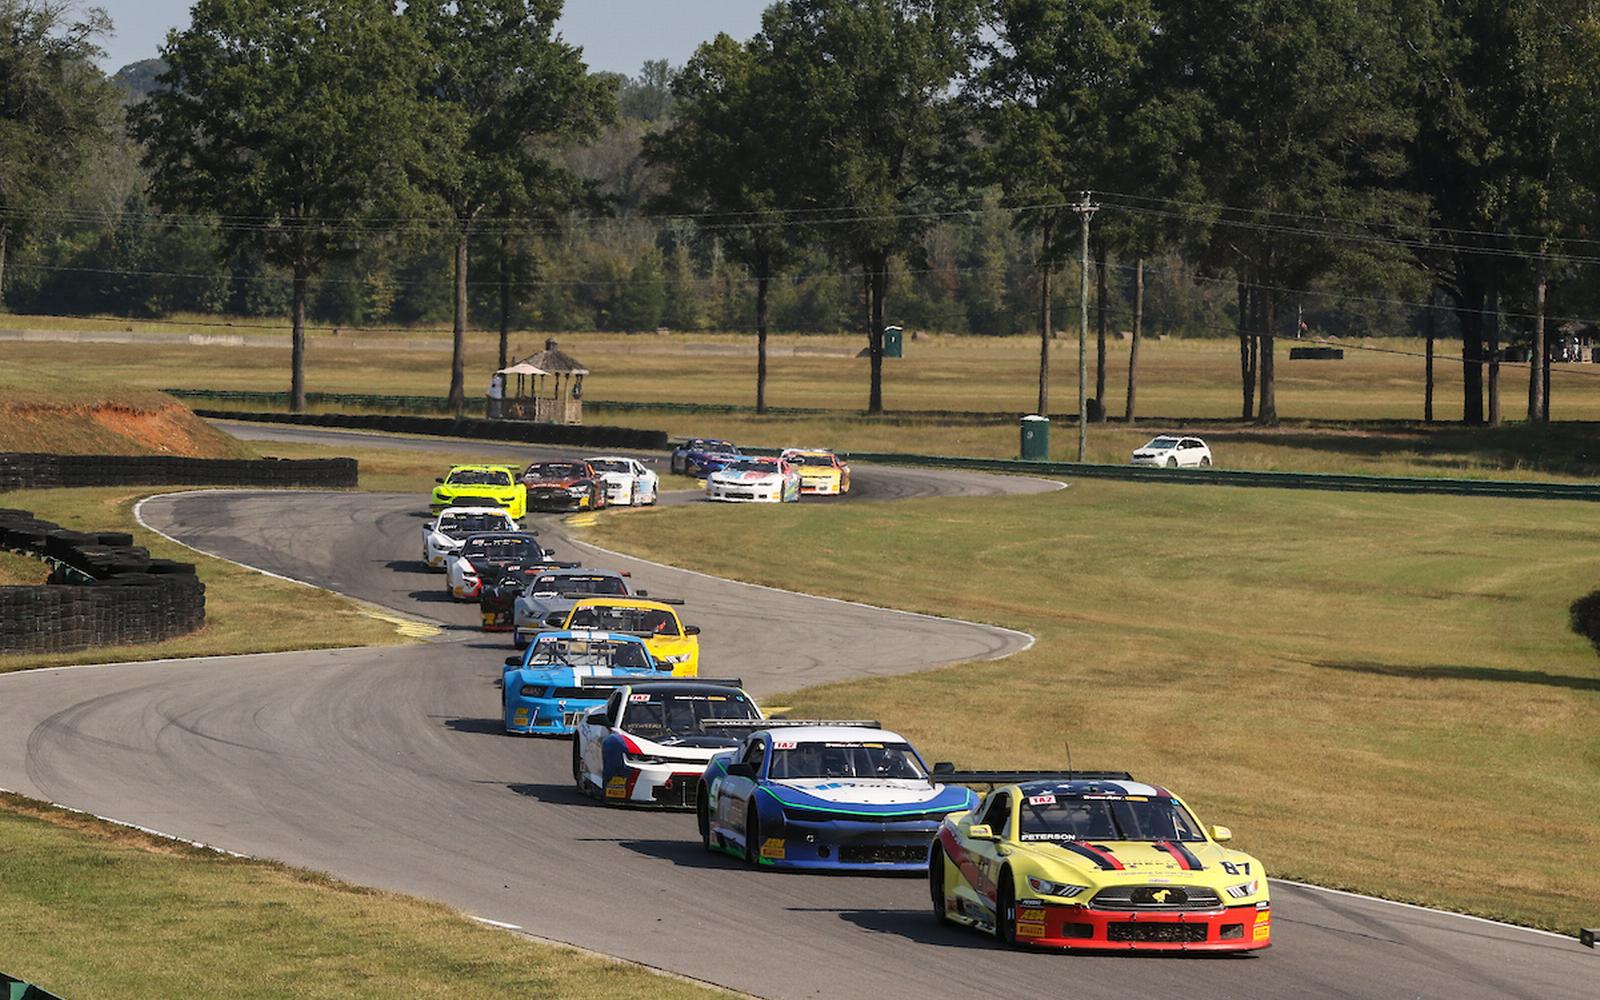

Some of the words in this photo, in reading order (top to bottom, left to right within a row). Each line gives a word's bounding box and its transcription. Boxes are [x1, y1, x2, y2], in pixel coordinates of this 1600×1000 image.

[1032, 796, 1054, 804] TA2
[1021, 833, 1076, 841] PETERSON
[1219, 861, 1250, 876] 87
